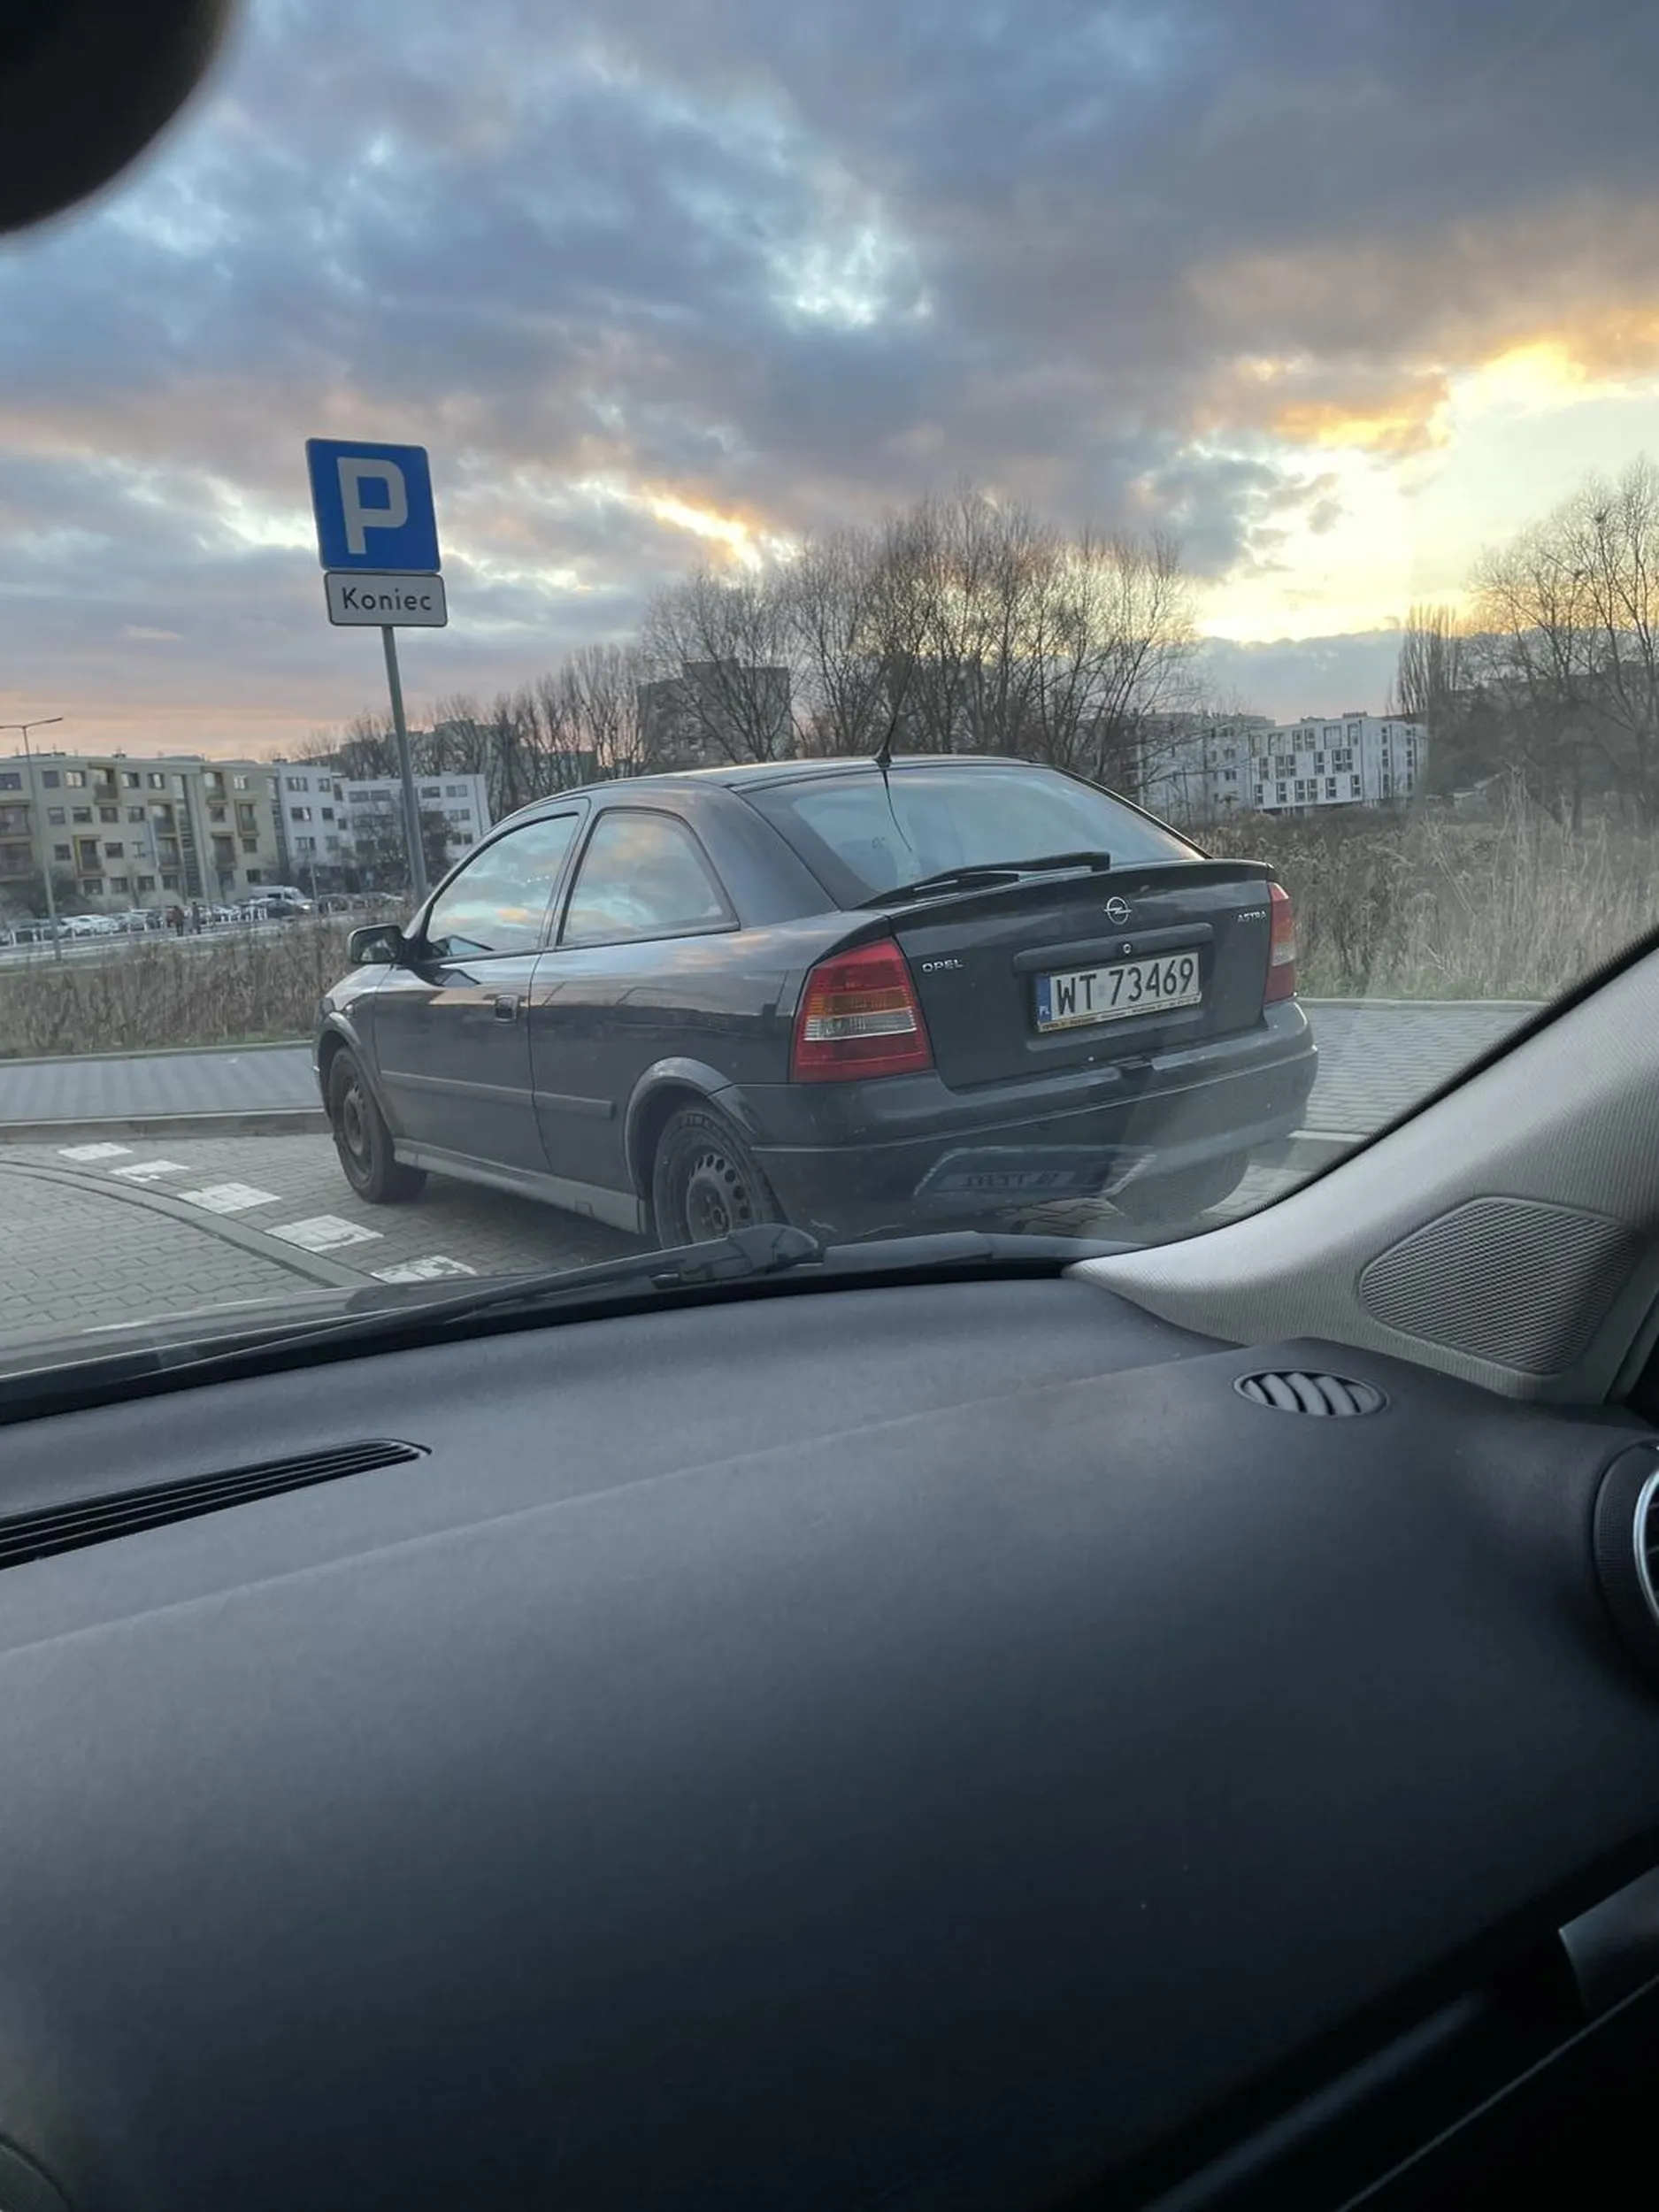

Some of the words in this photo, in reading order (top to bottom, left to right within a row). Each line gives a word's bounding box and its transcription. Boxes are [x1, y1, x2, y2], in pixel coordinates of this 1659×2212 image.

[336, 457, 408, 555] P
[342, 587, 432, 611] Koniec
[922, 959, 964, 973] OPEL
[1056, 973, 1097, 1015] WT
[1108, 957, 1194, 1006] 73469
